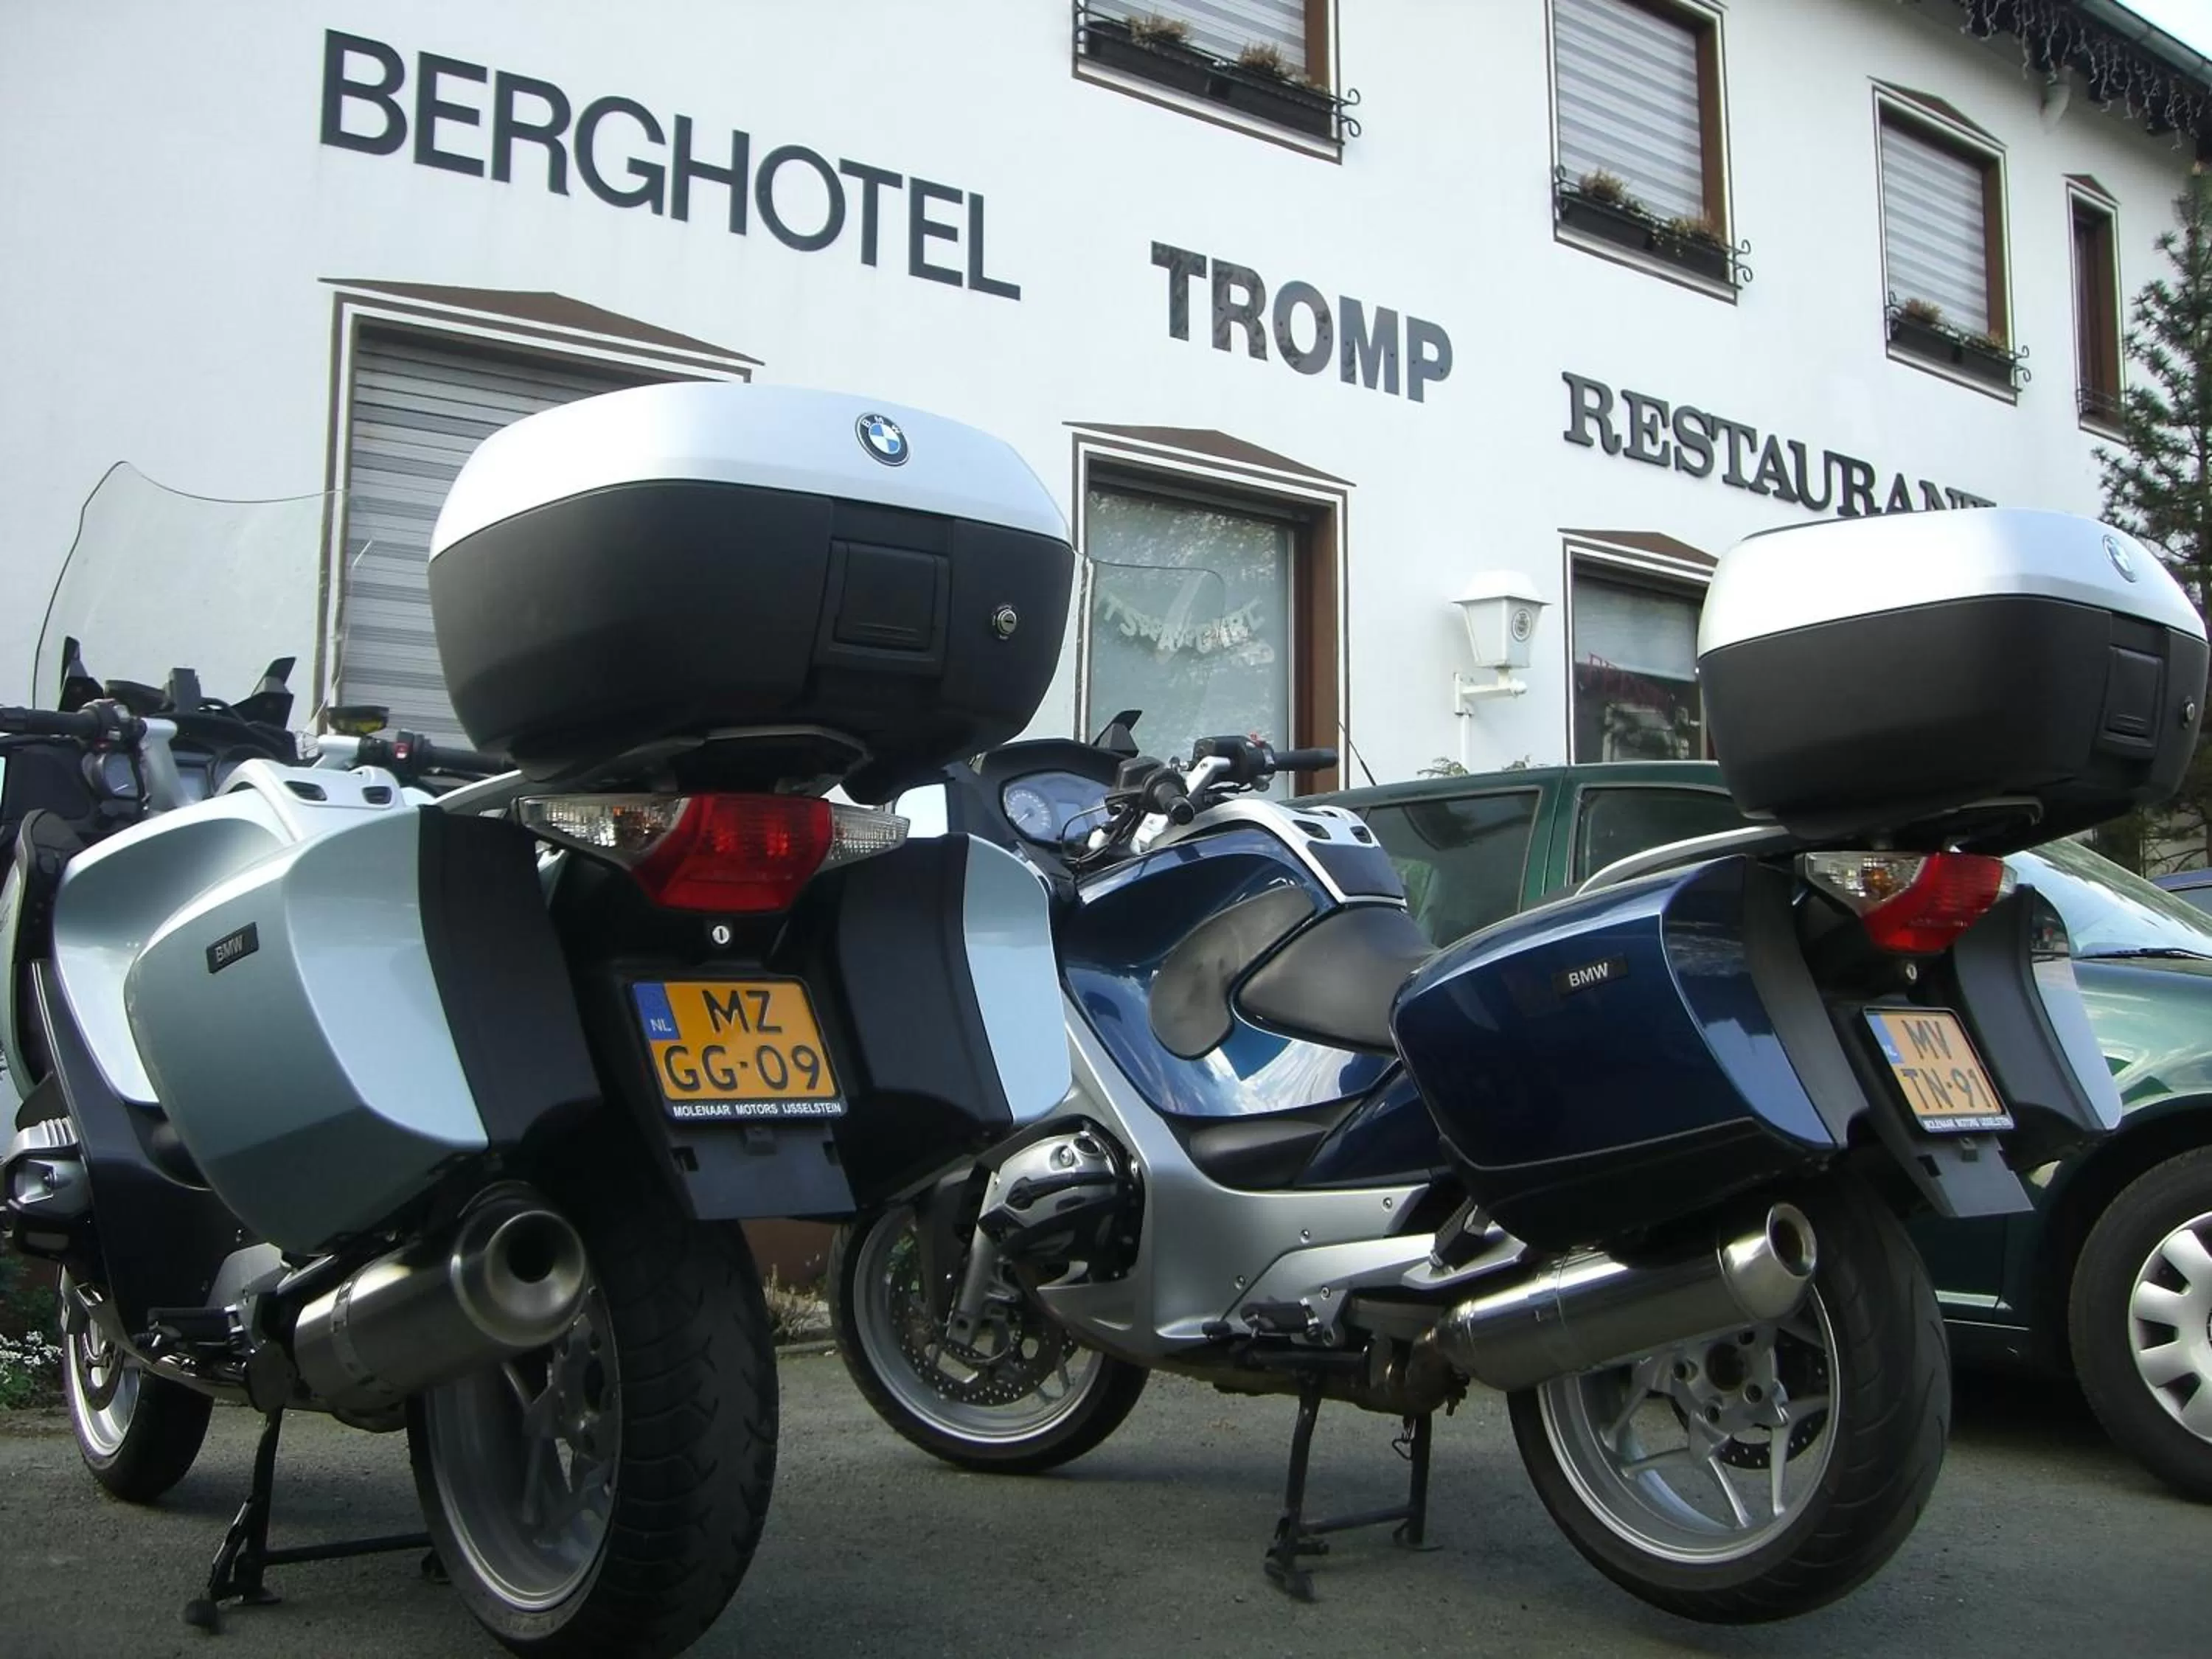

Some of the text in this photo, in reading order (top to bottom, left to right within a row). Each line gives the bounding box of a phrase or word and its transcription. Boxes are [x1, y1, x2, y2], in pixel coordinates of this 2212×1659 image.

[319, 28, 1997, 515] BERGHOTEL TROMP RESTAURA
[215, 934, 243, 962] BMW
[1568, 961, 1608, 987] BMW
[650, 1018, 672, 1032] NL
[702, 990, 782, 1033] MZ
[1901, 1020, 1952, 1060] MV
[664, 1045, 820, 1091] GG-09
[1900, 1068, 1991, 1110] TN-91
[672, 1105, 731, 1117] MOLENAAR
[735, 1104, 779, 1116] MOTORS
